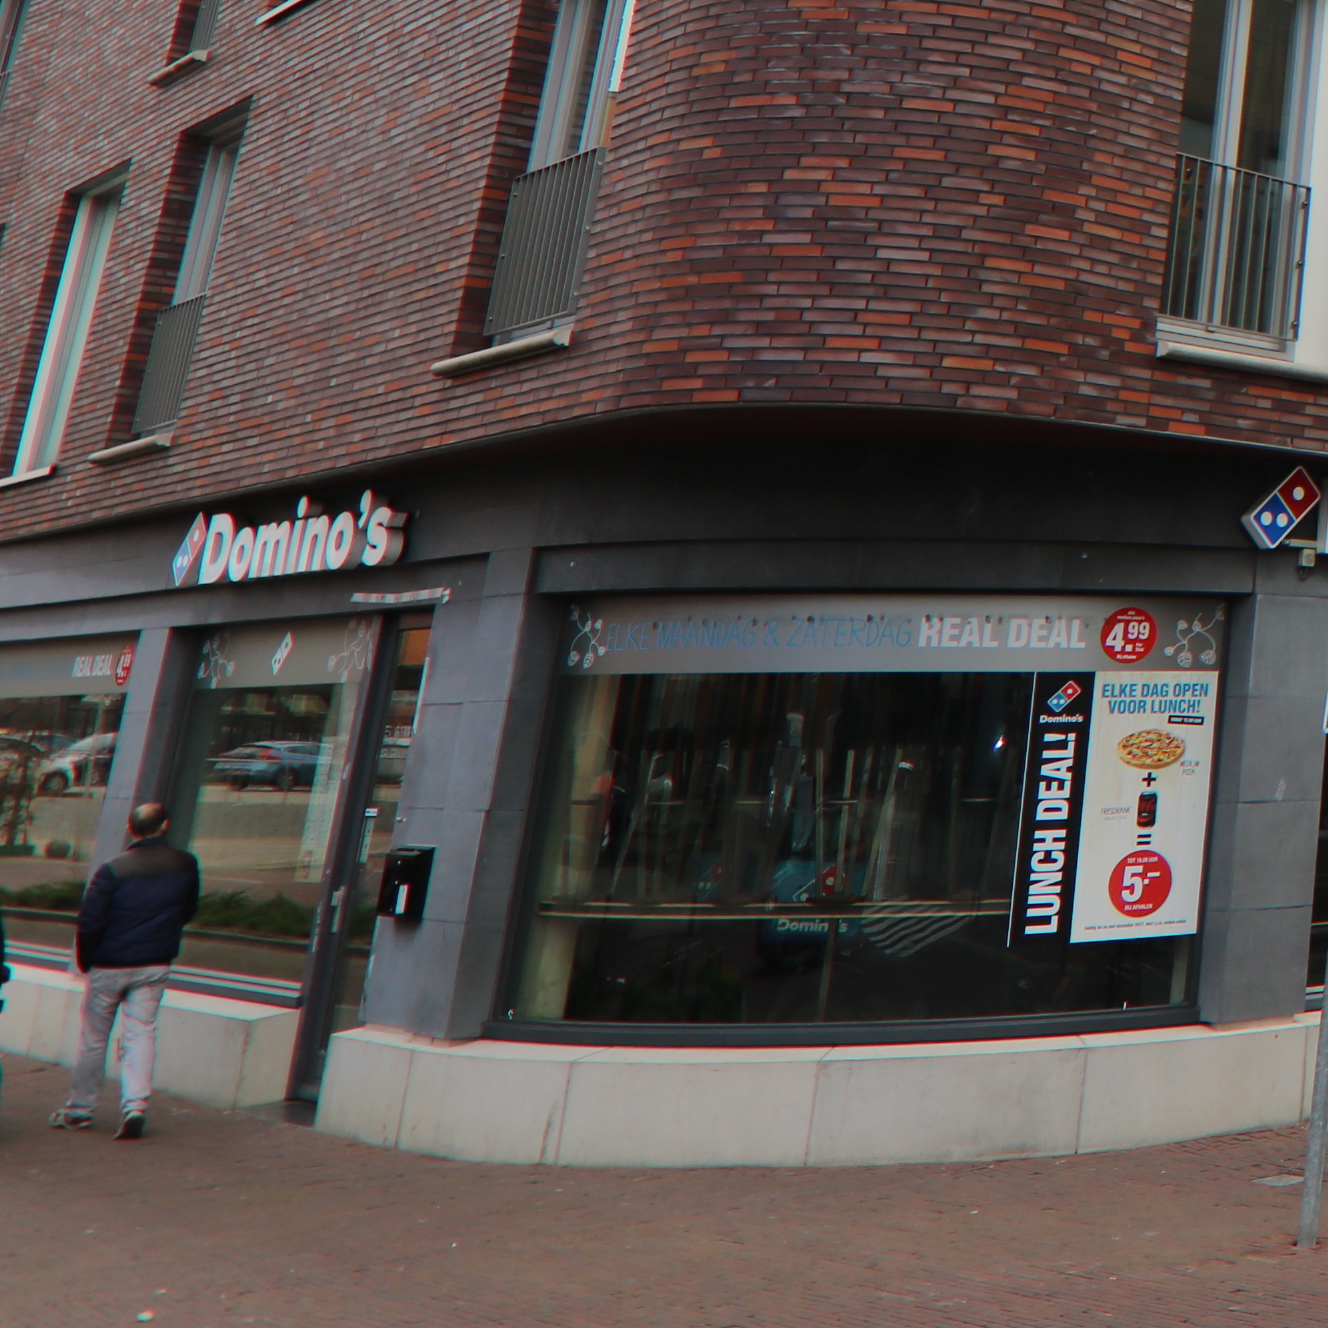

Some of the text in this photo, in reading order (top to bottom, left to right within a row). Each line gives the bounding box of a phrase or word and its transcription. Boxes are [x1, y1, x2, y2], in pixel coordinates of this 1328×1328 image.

[198, 489, 395, 585] Domino's
[606, 617, 1086, 651] ELKE MAANDAG & ZATERDAG REAL DEAL
[1105, 621, 1150, 652] 4.99
[72, 655, 92, 678] REAL
[92, 654, 112, 677] DEAL
[1102, 683, 1209, 698] ELKE DAG OPEN
[1108, 699, 1201, 714] VOOR LUNCH!
[1039, 714, 1084, 724] Domino's
[1024, 732, 1077, 935] LUNCH DEAL!
[777, 919, 848, 932] Domin's
